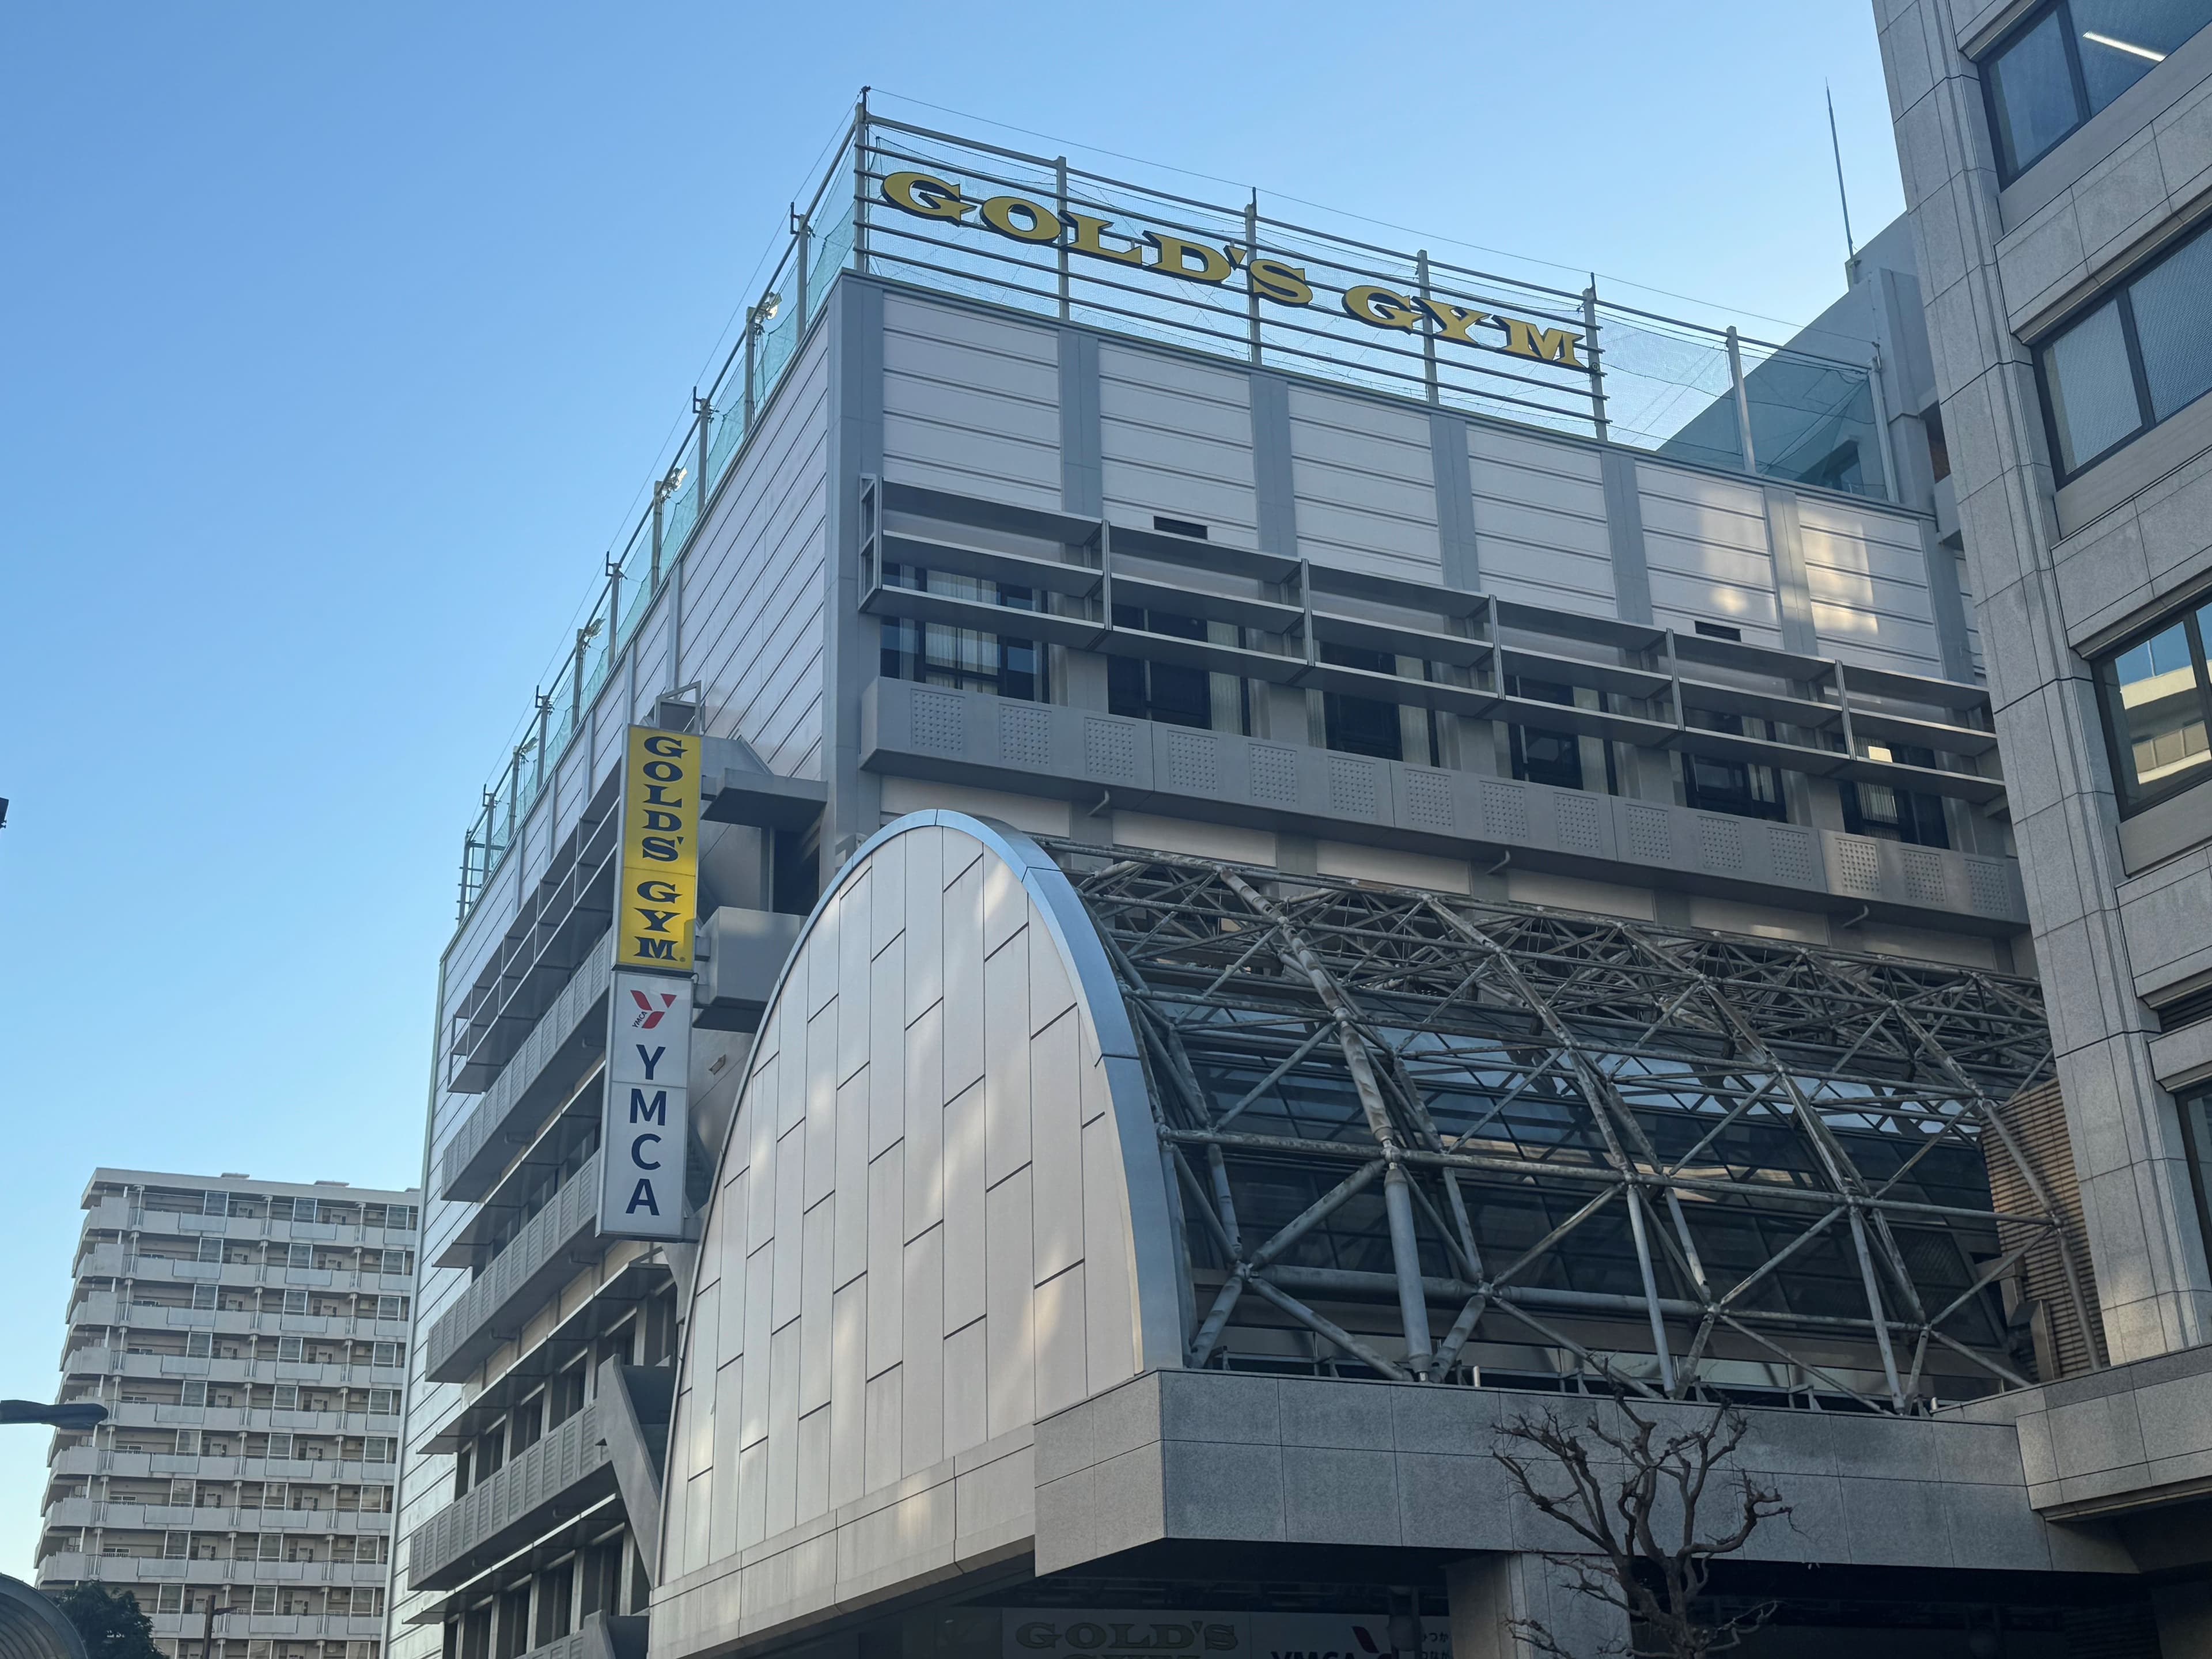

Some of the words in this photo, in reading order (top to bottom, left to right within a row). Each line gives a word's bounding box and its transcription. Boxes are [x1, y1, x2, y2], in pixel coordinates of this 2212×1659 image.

[881, 171, 1313, 308] GOLD'S
[632, 1011, 648, 1028] YMCA
[625, 1044, 667, 1216] YMCA
[1015, 1620, 1238, 1651] GOLD'S
